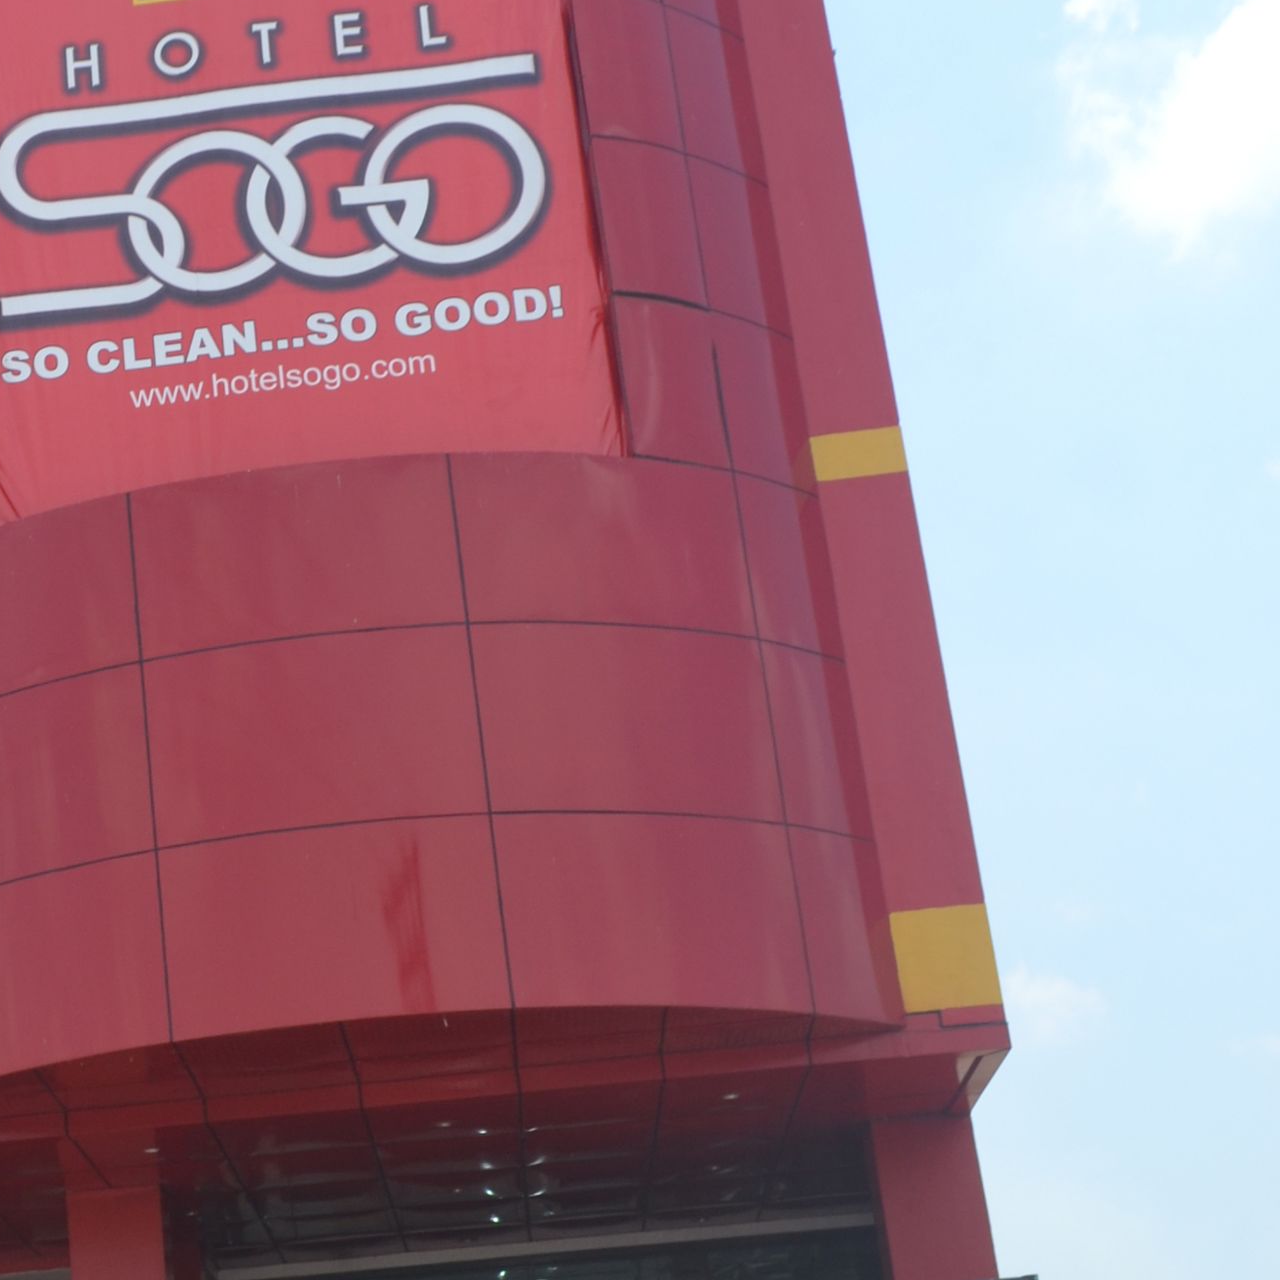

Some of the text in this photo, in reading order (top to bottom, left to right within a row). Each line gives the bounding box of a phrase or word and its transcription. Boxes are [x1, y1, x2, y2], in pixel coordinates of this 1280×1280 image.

[64, 4, 448, 90] HOTEL
[0, 345, 70, 384] SO
[394, 285, 565, 336] GOOD!
[129, 350, 437, 409] www.hotelsogo.com
